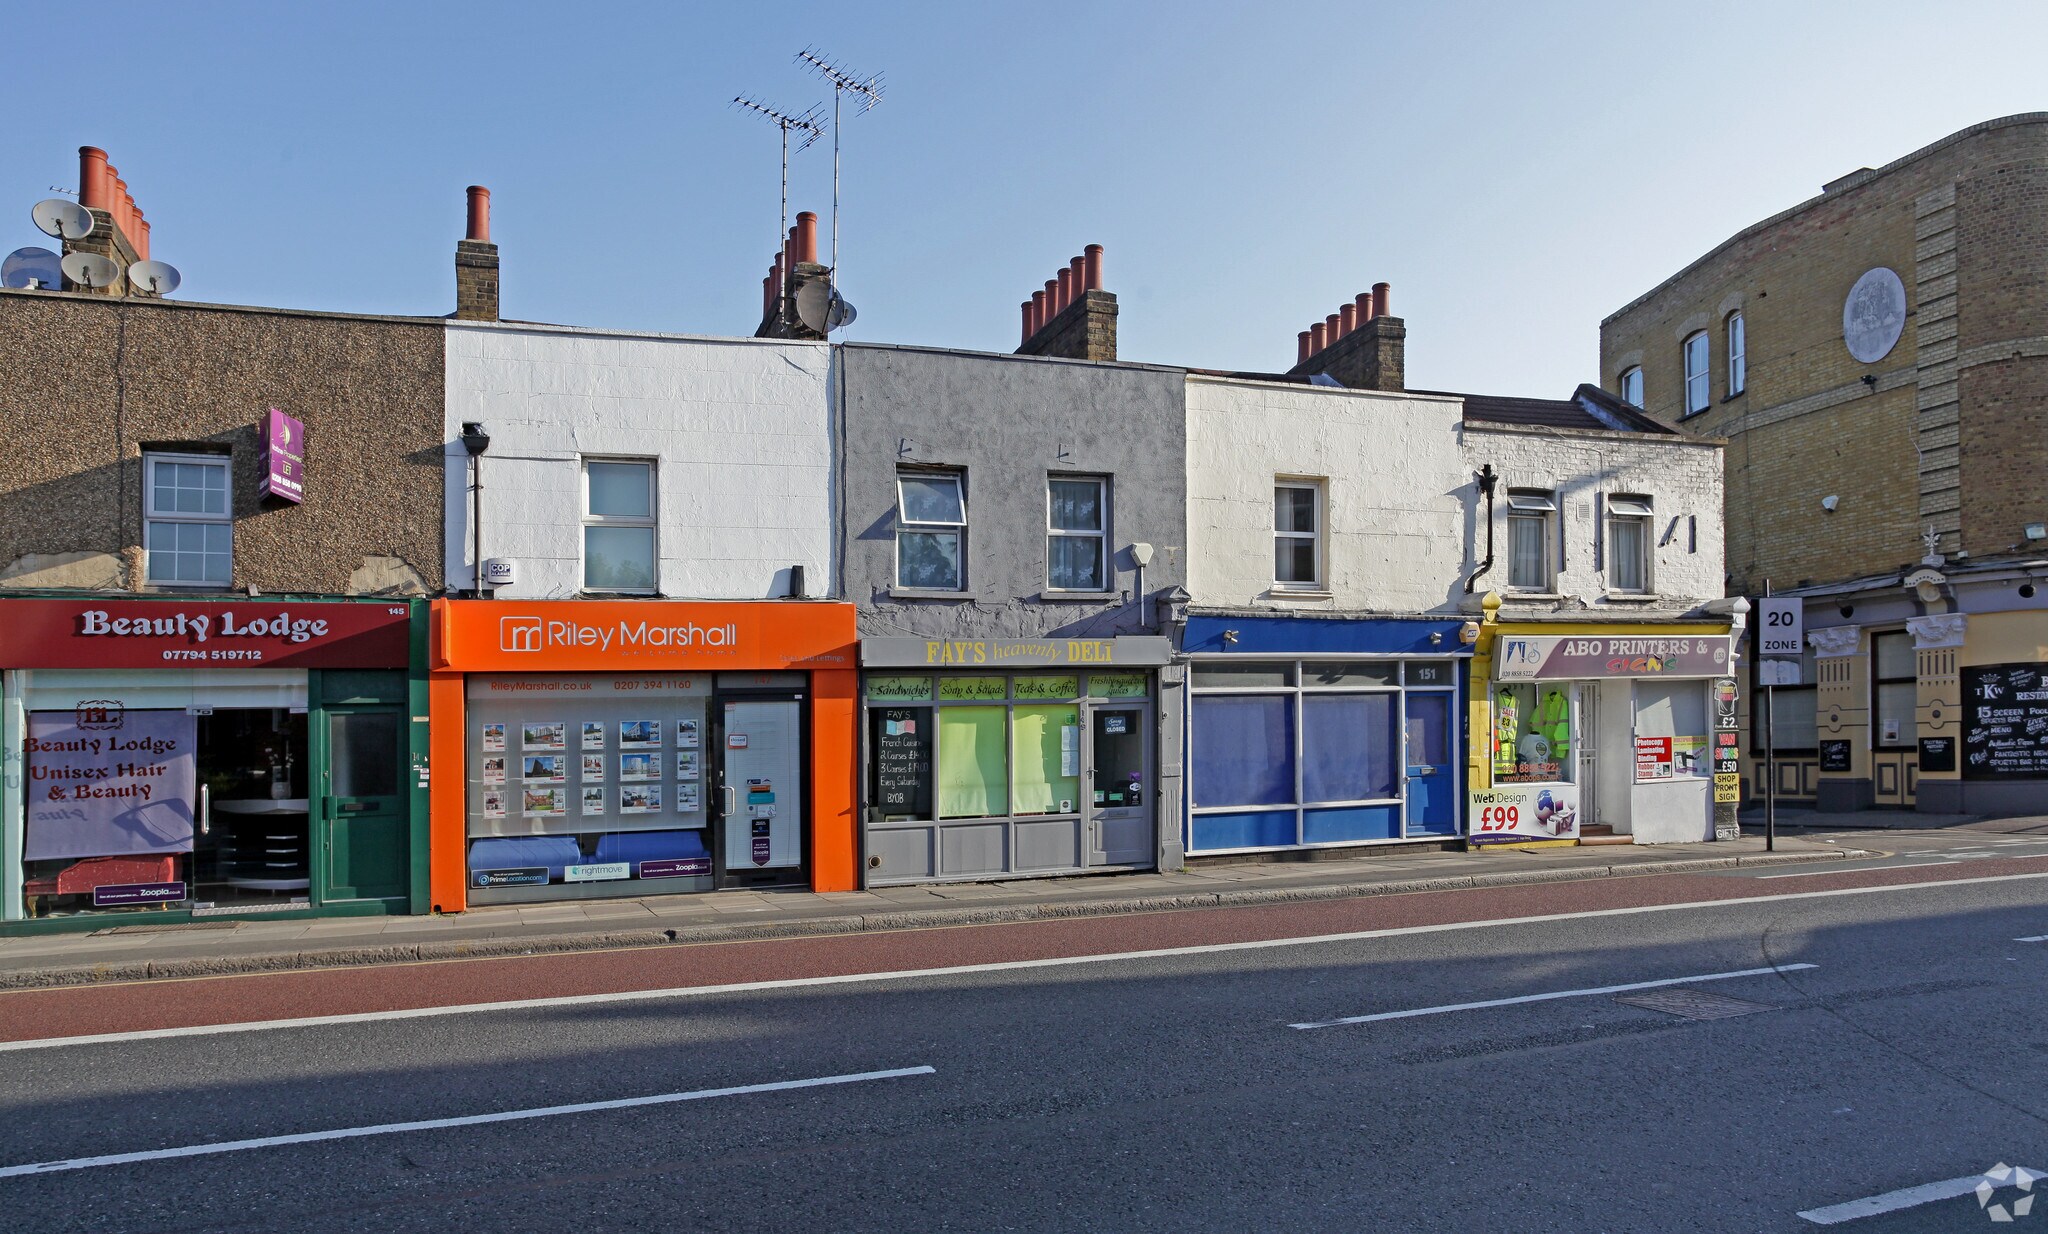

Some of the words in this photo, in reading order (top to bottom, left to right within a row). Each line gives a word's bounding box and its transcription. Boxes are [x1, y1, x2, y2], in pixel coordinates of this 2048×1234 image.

[491, 564, 510, 572] COP
[1768, 612, 1794, 626] 20
[82, 610, 209, 642] Beauty
[222, 611, 328, 642] Lodge
[548, 621, 614, 651] Riley
[620, 621, 736, 646] Marshall
[1564, 641, 1602, 656] ABO
[1608, 640, 1690, 656] PRINTERS
[1696, 640, 1708, 655] &
[1764, 640, 1797, 650] ZONE
[163, 650, 206, 660] 07794
[211, 650, 261, 660] 519712
[926, 641, 986, 663] FAY'S
[993, 641, 1062, 663] heavenly
[1714, 652, 1724, 660] 153
[1606, 657, 1678, 674] SIGNS
[1418, 668, 1436, 680] 151
[491, 680, 592, 692] RileyMarshall.co.uk
[614, 681, 640, 690] 0207
[644, 680, 663, 690] 394
[666, 680, 691, 689] 1160
[876, 685, 930, 696] Sandwiches
[966, 686, 974, 694] &
[976, 684, 1004, 695] Salads
[1049, 682, 1076, 696] Coffee
[887, 710, 911, 720] FAY'S
[1502, 708, 1514, 717] SALE
[1978, 706, 1992, 718] 15
[1993, 708, 2024, 716] SCREEN
[22, 738, 101, 755] Beauty
[108, 736, 177, 755] Lodge
[881, 737, 902, 747] French
[1718, 734, 1736, 746] VAN
[880, 750, 886, 760] 2
[886, 750, 907, 760] Courses
[1714, 748, 1738, 760] SIGNS
[1994, 750, 2030, 758] FANTASTIC
[30, 765, 108, 780] Unisex
[116, 762, 167, 778] Hair
[880, 762, 886, 773] 3
[886, 762, 907, 773] Courses
[1722, 760, 1736, 772] £50
[880, 776, 896, 790] Every
[1716, 783, 1738, 792] FRONT
[48, 786, 66, 800] &
[74, 783, 152, 800] Beauty
[887, 792, 904, 804] BYOB
[1473, 794, 1494, 804] Web
[1496, 793, 1527, 804] Design
[1481, 806, 1519, 831] £99
[1716, 828, 1740, 839] GIFTS
[581, 865, 623, 877] rightmove
[490, 874, 542, 883] PrimeLocation.com
